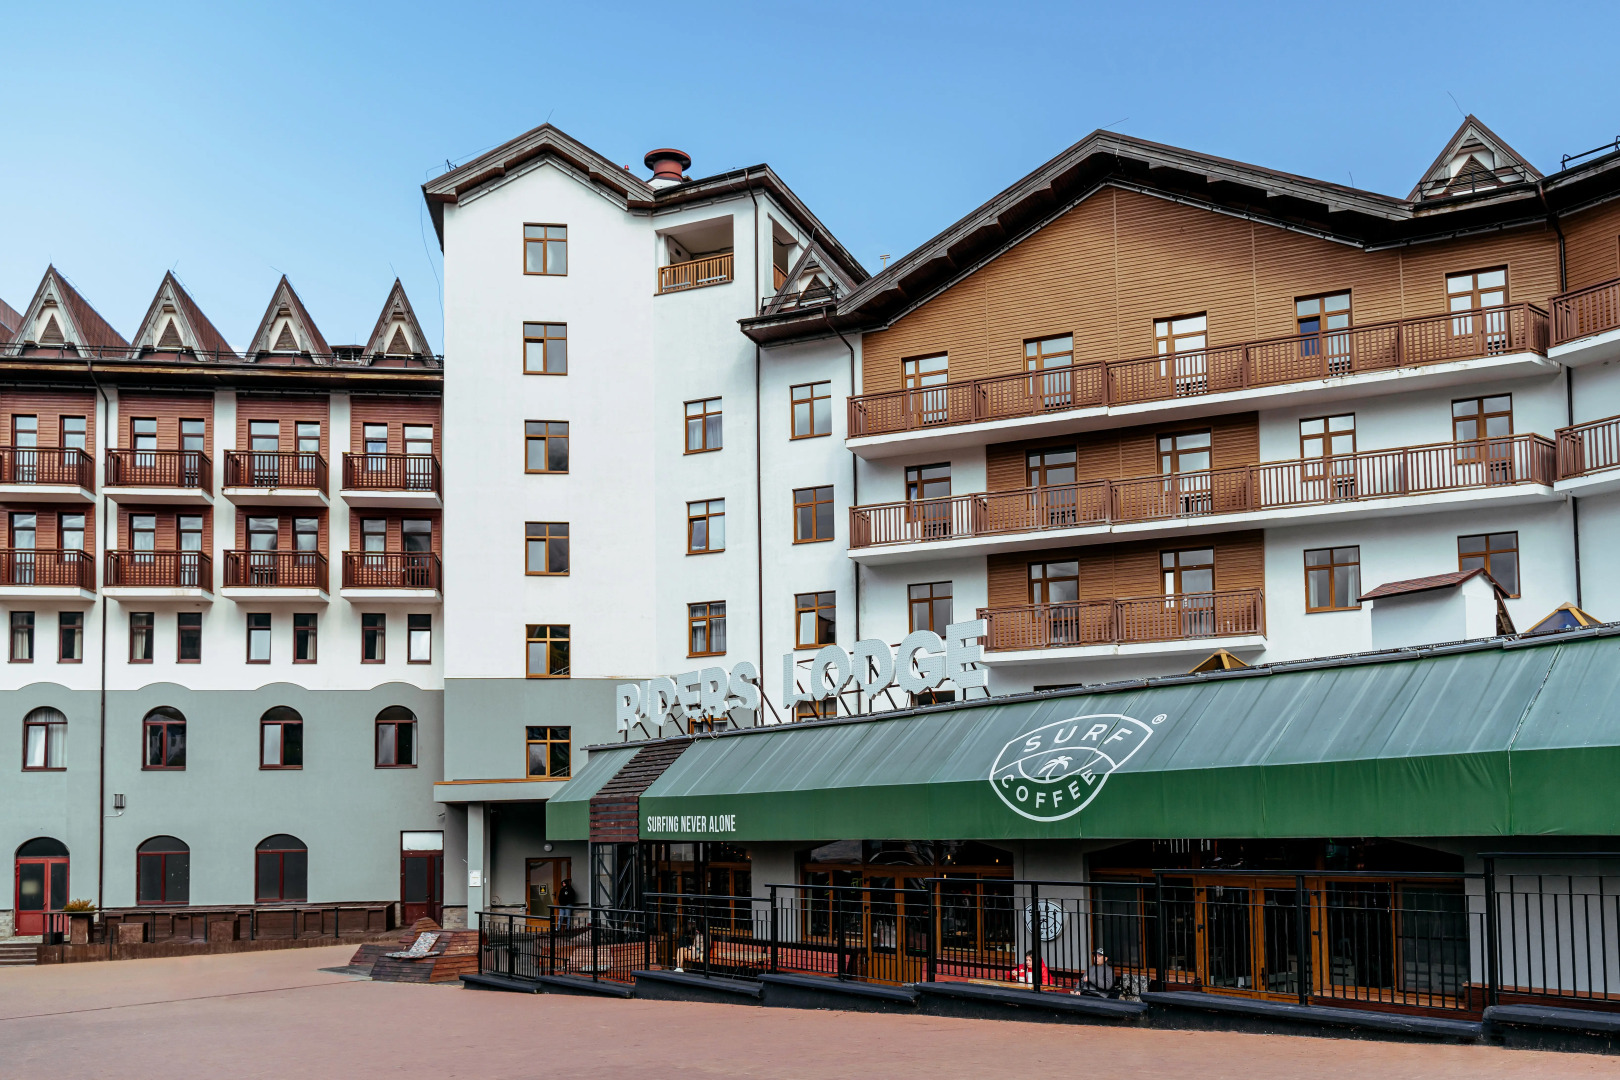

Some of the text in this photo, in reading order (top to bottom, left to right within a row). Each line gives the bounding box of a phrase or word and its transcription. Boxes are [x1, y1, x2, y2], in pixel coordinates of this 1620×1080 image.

[616, 619, 988, 733] RIDERS LODGE
[1023, 723, 1132, 752] SURF
[1002, 769, 1096, 808] COFFEE
[647, 814, 736, 833] SURFING NEVER ALONE
